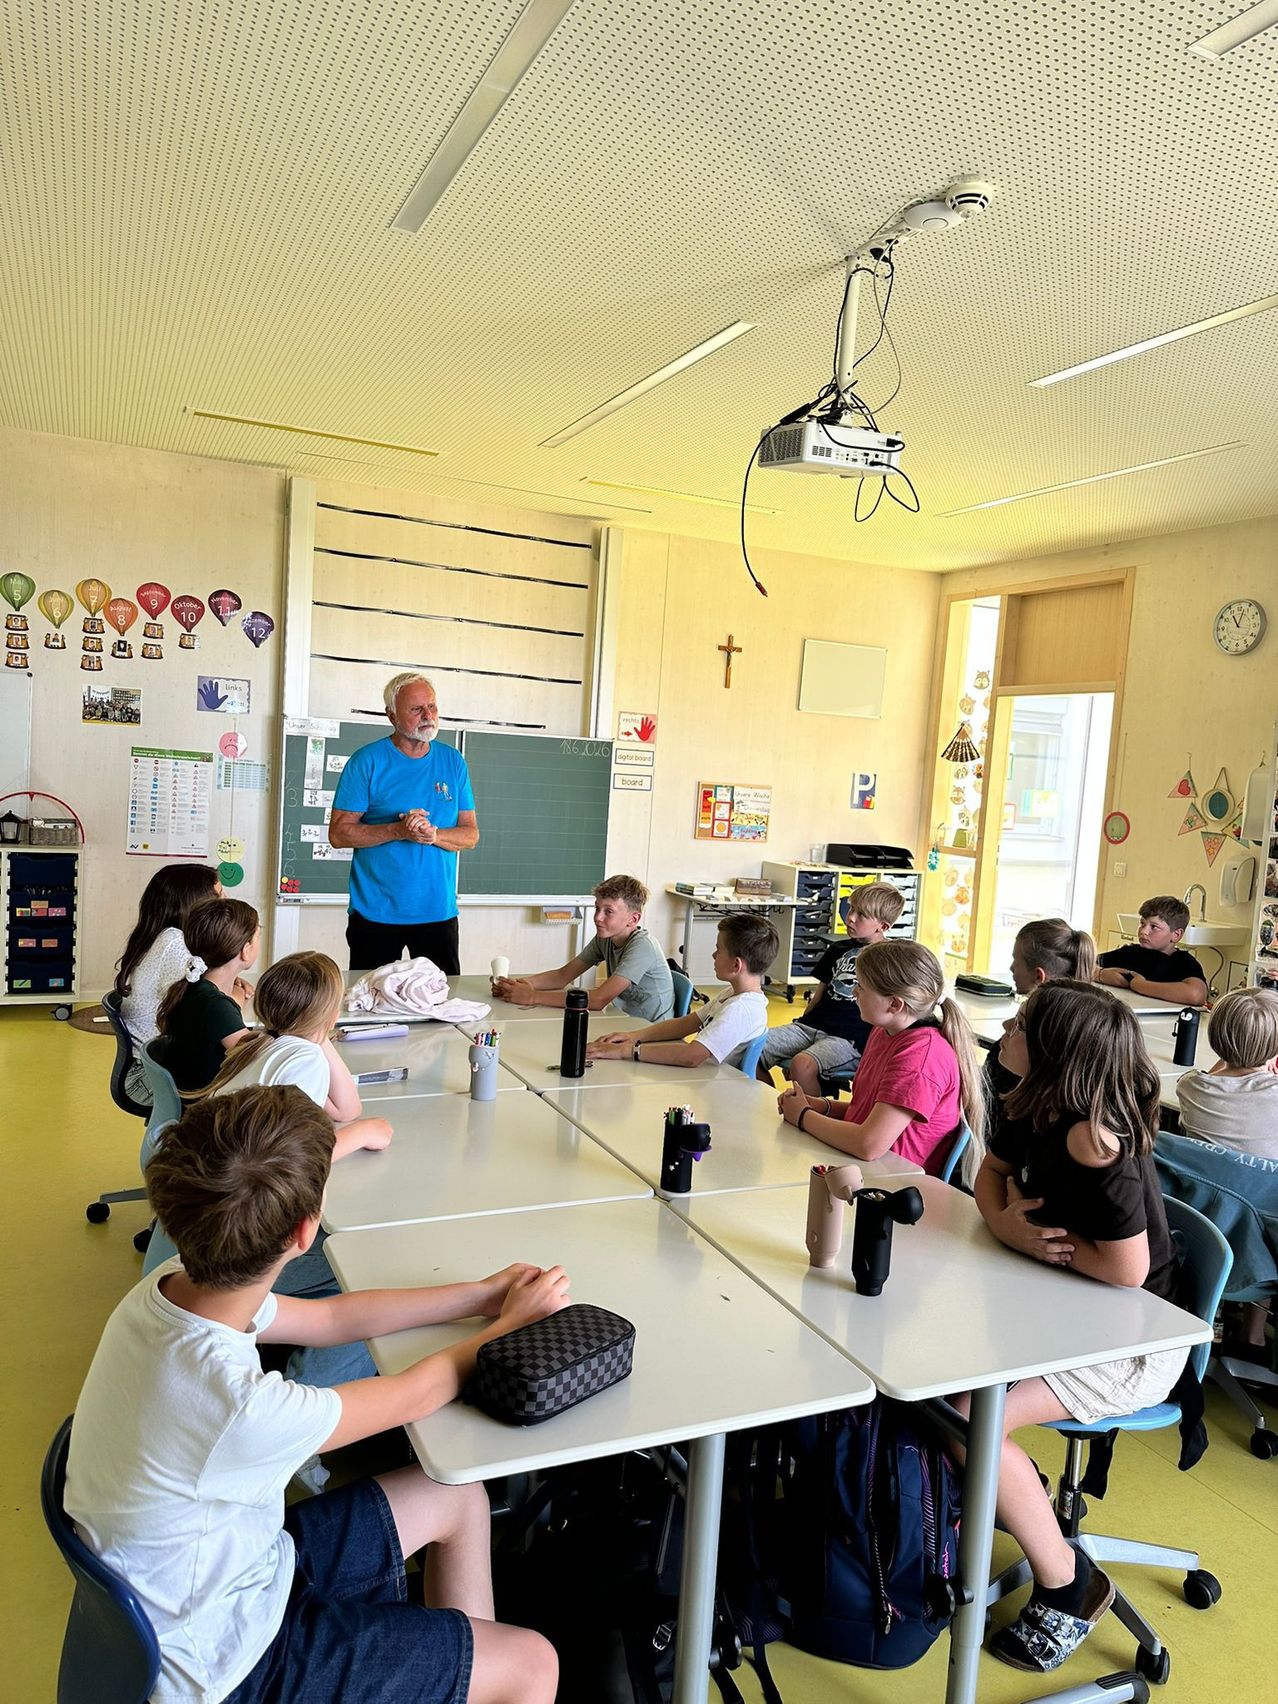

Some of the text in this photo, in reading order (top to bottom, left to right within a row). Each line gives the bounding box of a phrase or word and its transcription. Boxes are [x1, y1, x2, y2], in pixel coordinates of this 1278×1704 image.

[13, 590, 21, 601] 5
[89, 595, 98, 604] 7
[150, 598, 158, 609] 9
[174, 602, 201, 610] Oktober
[53, 610, 61, 618] 6
[218, 605, 230, 616] 11
[117, 615, 126, 625] 8
[180, 611, 196, 622] 10
[251, 627, 266, 638] 12
[617, 753, 634, 761] digital
[621, 777, 644, 786] board
[852, 772, 875, 805] P
